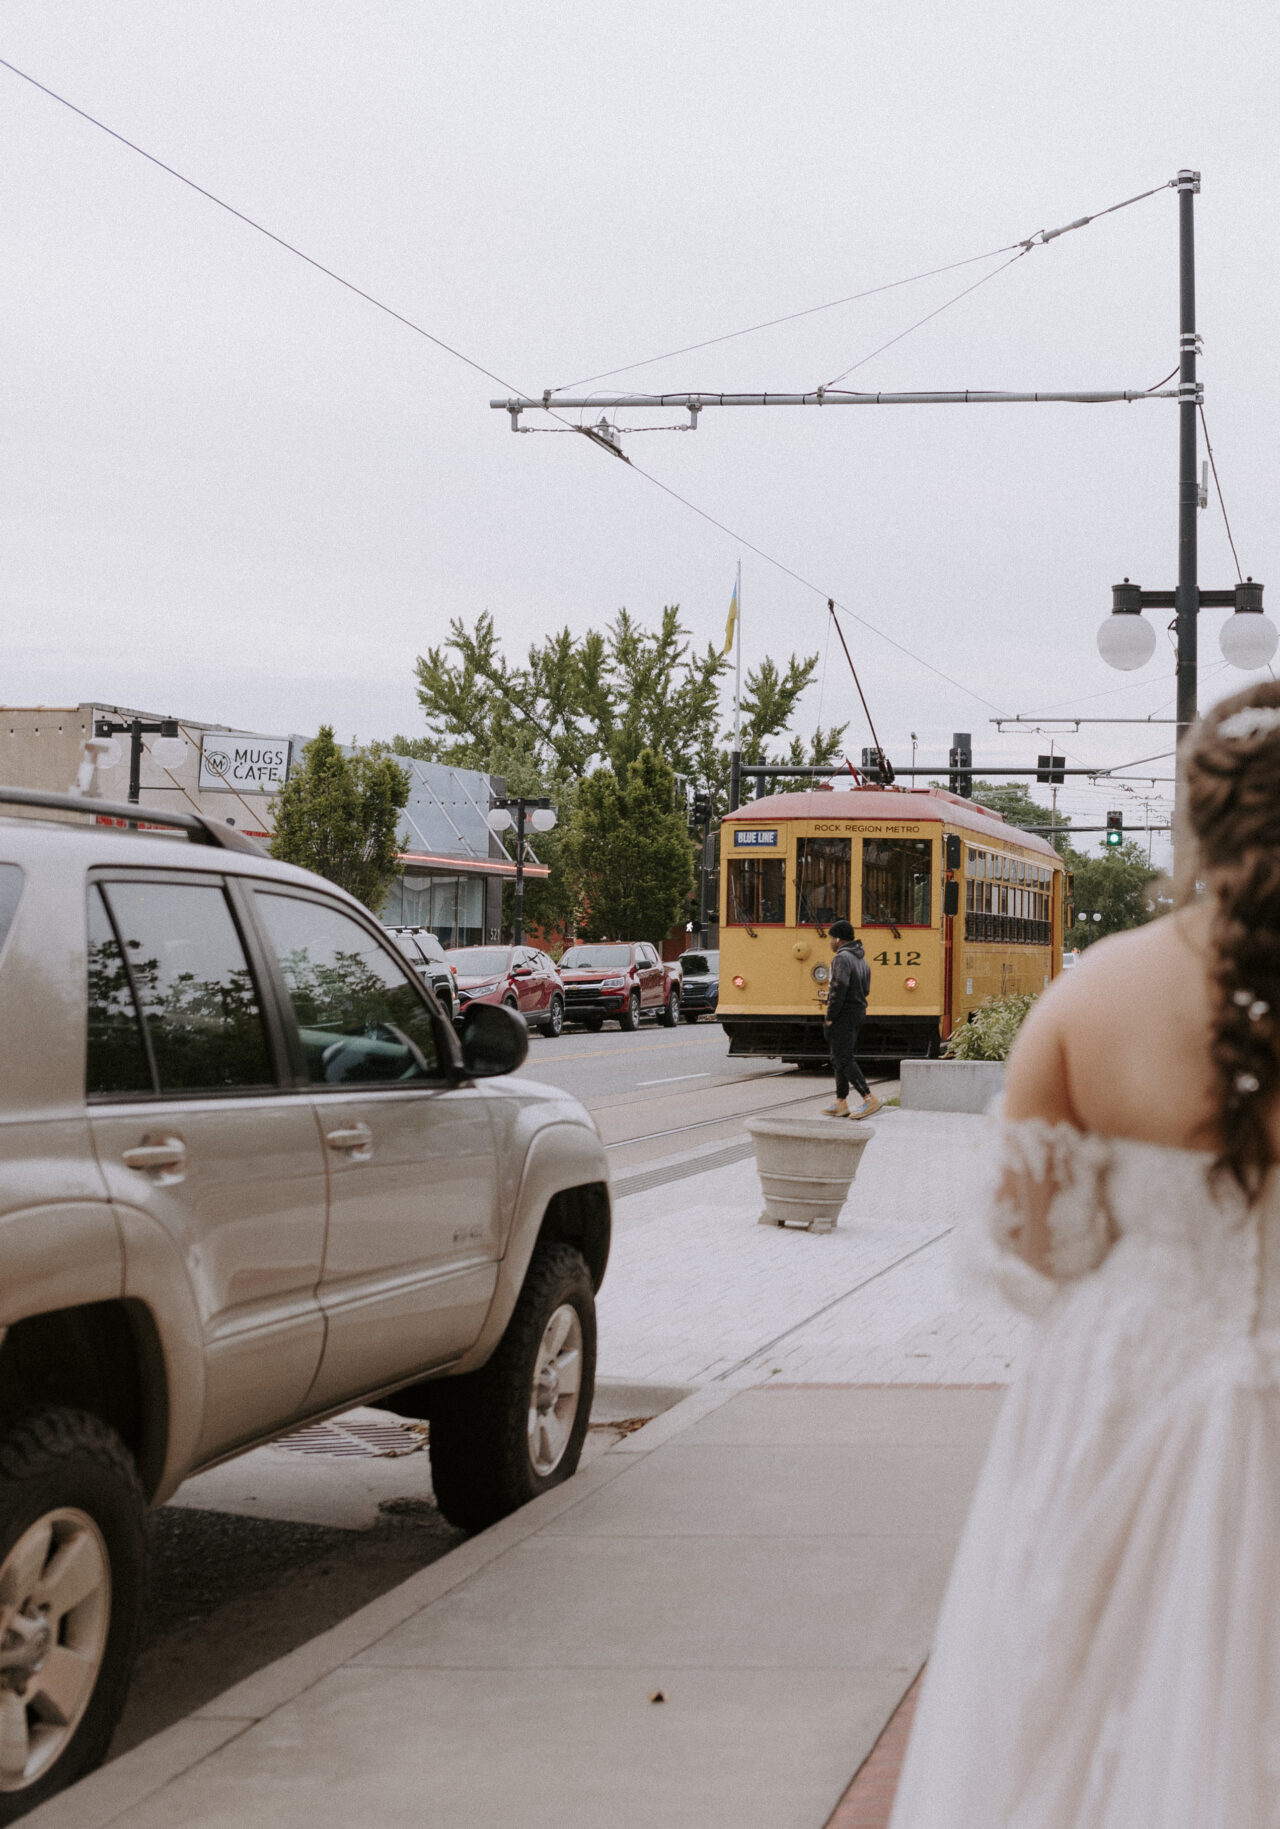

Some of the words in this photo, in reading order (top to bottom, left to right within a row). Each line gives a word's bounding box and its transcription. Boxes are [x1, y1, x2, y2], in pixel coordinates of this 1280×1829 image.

[234, 748, 284, 766] MUGS
[233, 765, 279, 782] CAFE
[814, 824, 841, 832] ROCK
[845, 824, 882, 833] REGION
[885, 825, 920, 833] METRO
[737, 831, 757, 843] BLUE
[757, 831, 775, 843] LINE
[490, 928, 500, 941] 521
[873, 951, 921, 966] 412
